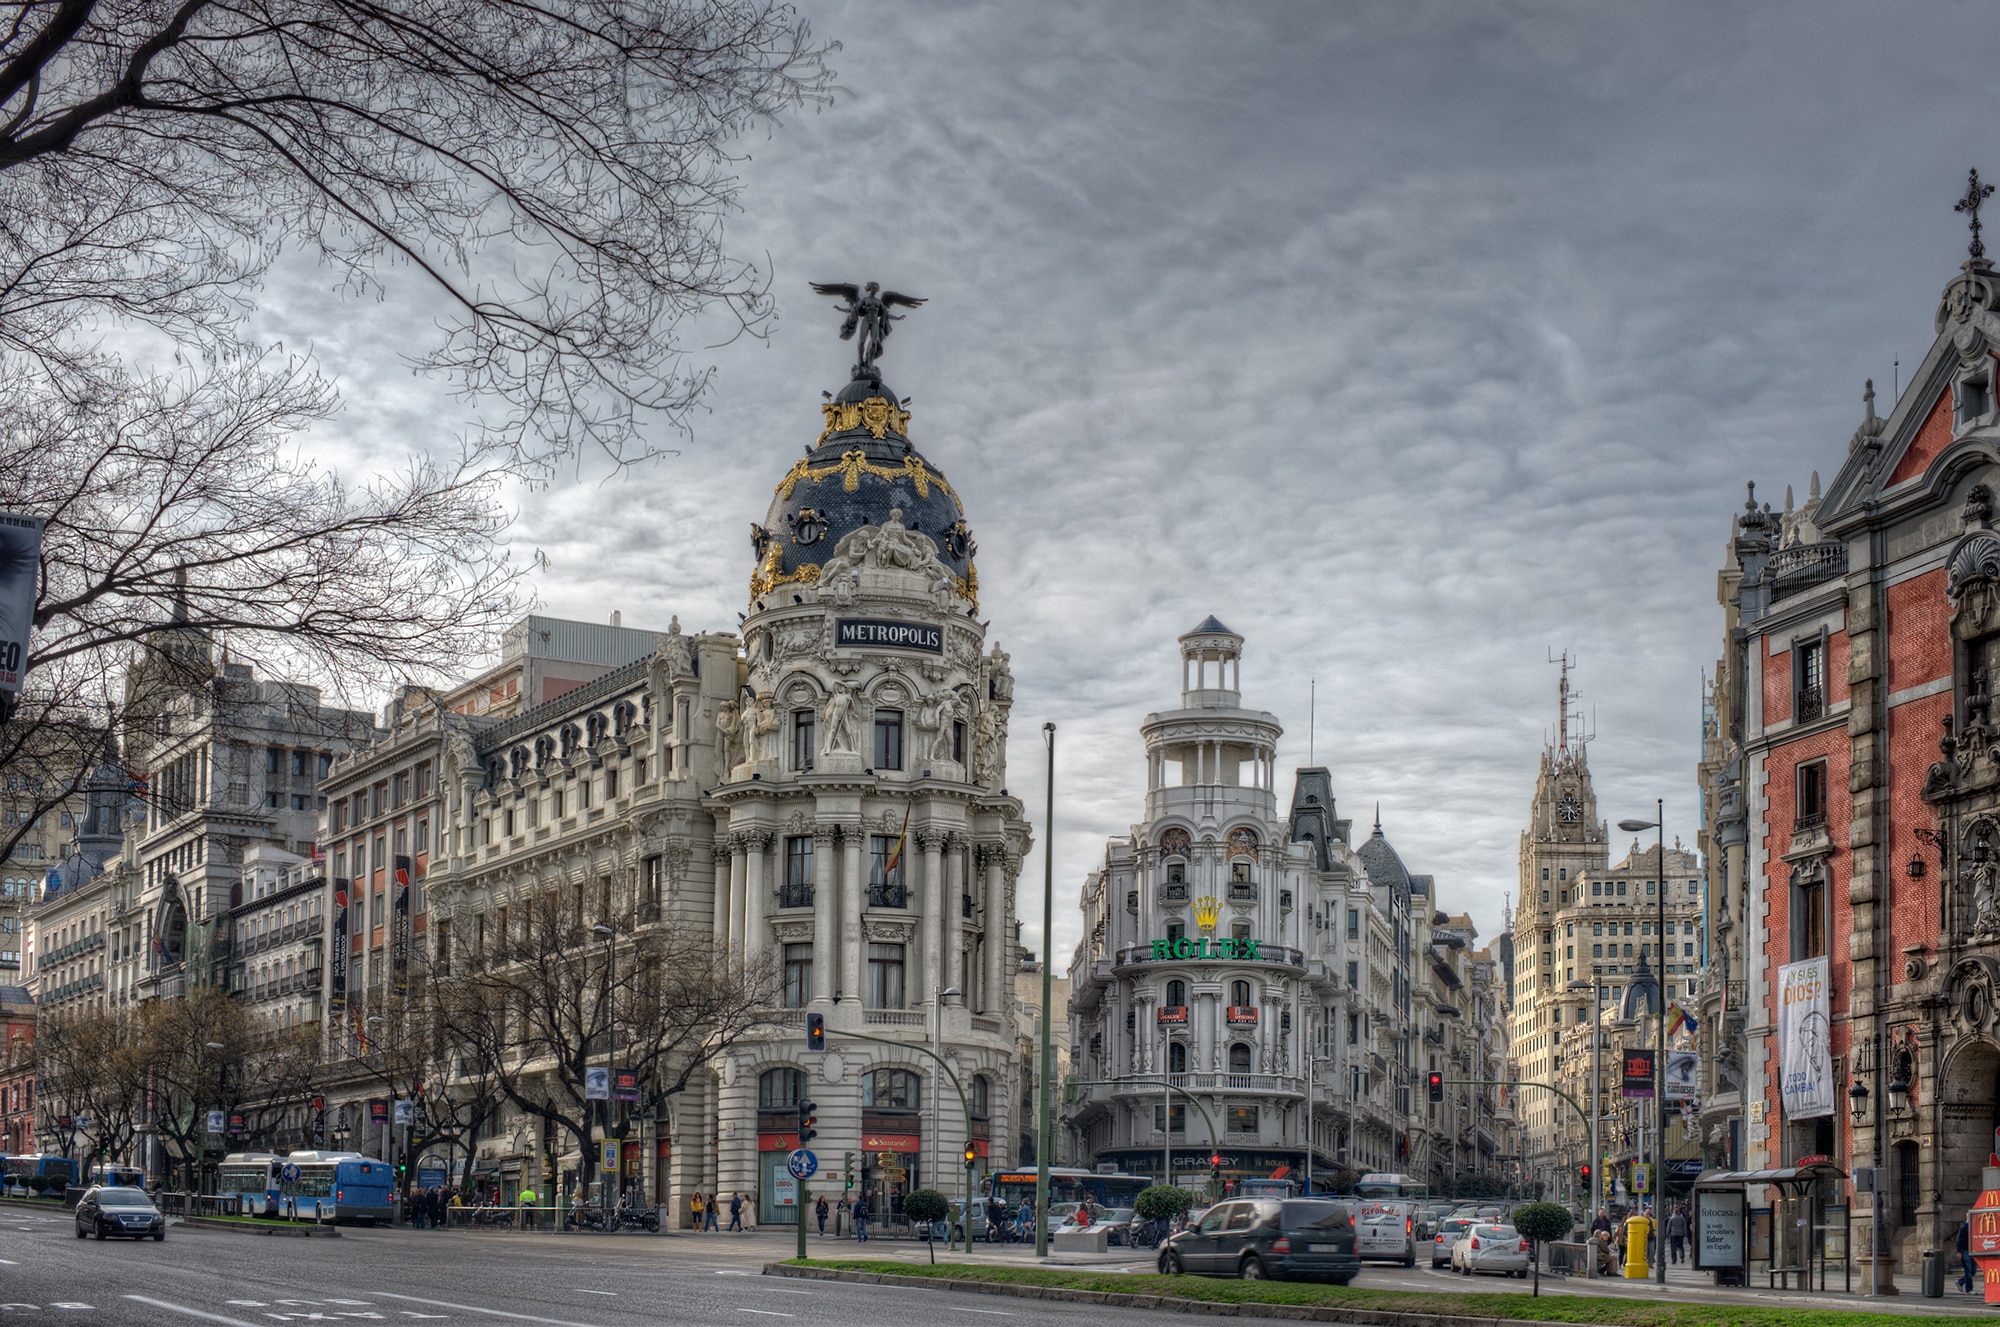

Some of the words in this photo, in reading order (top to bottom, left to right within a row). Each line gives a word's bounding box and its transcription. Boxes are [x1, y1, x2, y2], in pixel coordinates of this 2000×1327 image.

[6, 517, 12, 526] 10
[13, 518, 19, 527] DE
[21, 520, 36, 529] ABRIL
[842, 624, 939, 647] METROPOLIS
[6, 672, 17, 684] GAS
[1151, 938, 1262, 960] ROLEX
[1798, 969, 1806, 981] SI
[1808, 967, 1818, 978] ES
[1784, 980, 1821, 1006] DIOS?
[1172, 1157, 1239, 1166] GRASSY
[1361, 1208, 1400, 1217] REFORMAS
[262, 1311, 450, 1320] TAXI
